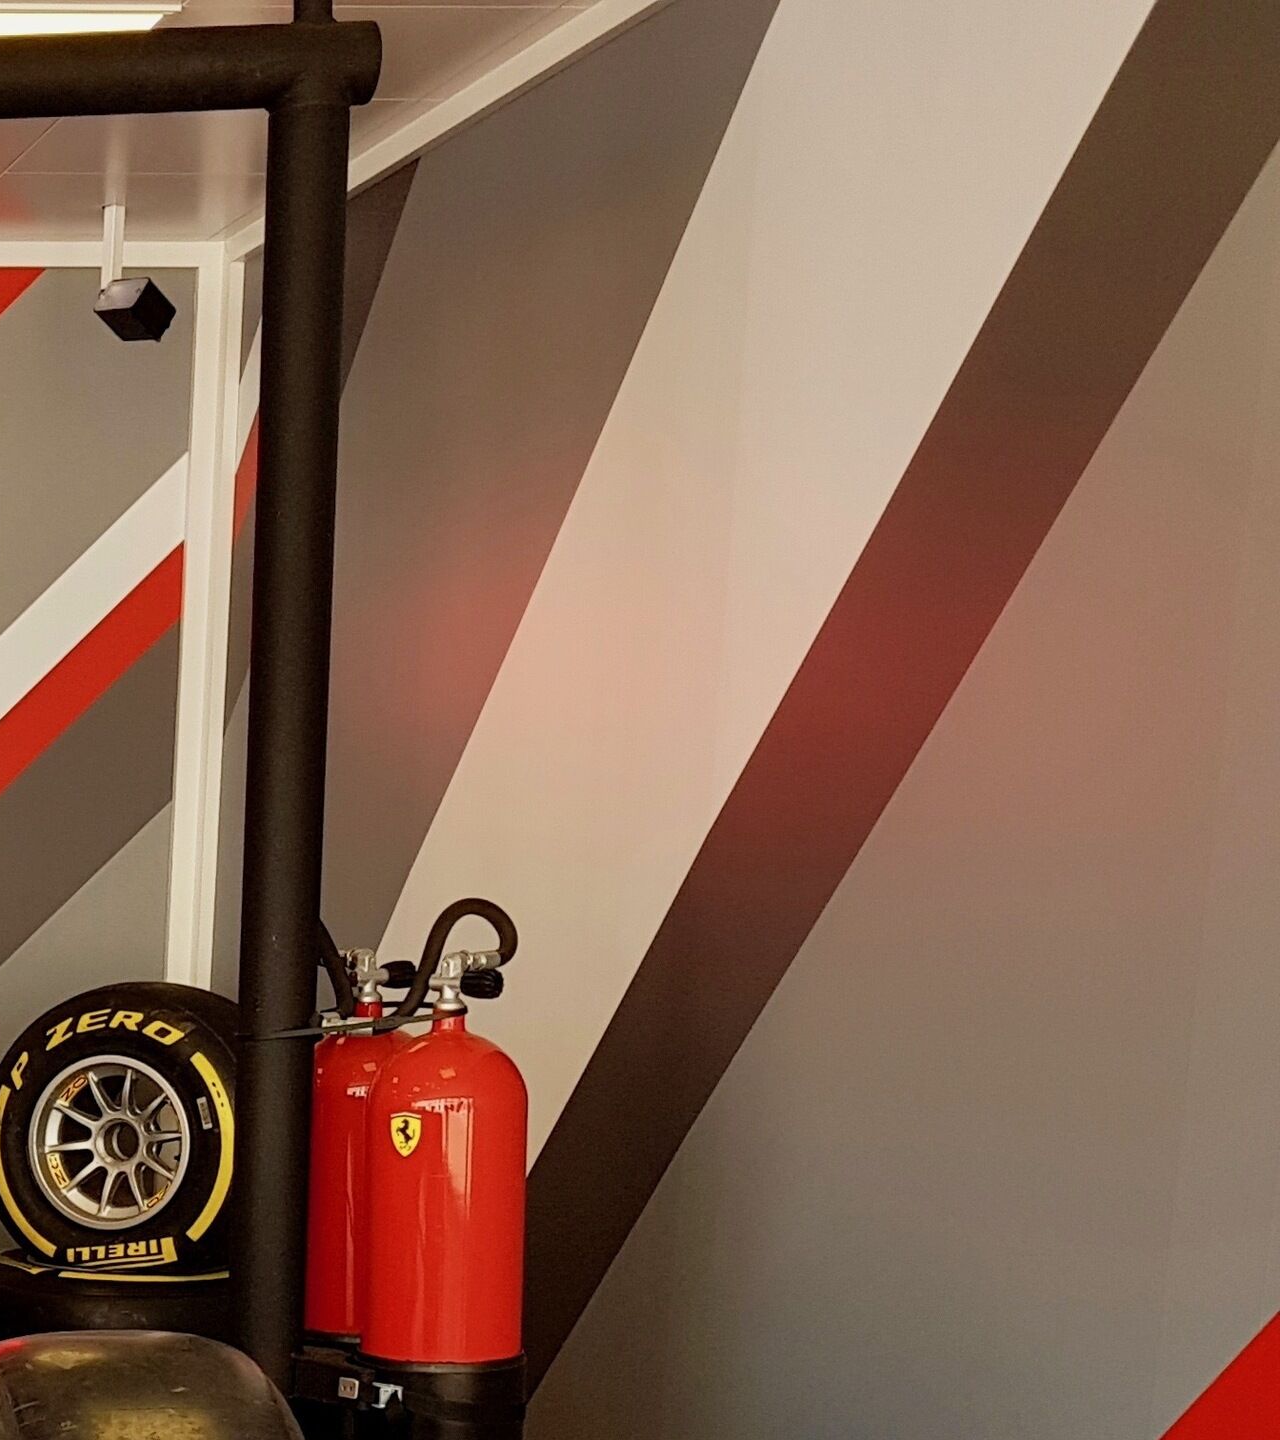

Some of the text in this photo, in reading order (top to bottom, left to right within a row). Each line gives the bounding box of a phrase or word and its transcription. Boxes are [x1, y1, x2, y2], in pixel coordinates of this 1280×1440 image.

[10, 1007, 186, 1091] P ZERO
[66, 1236, 179, 1271] PIRELLI
